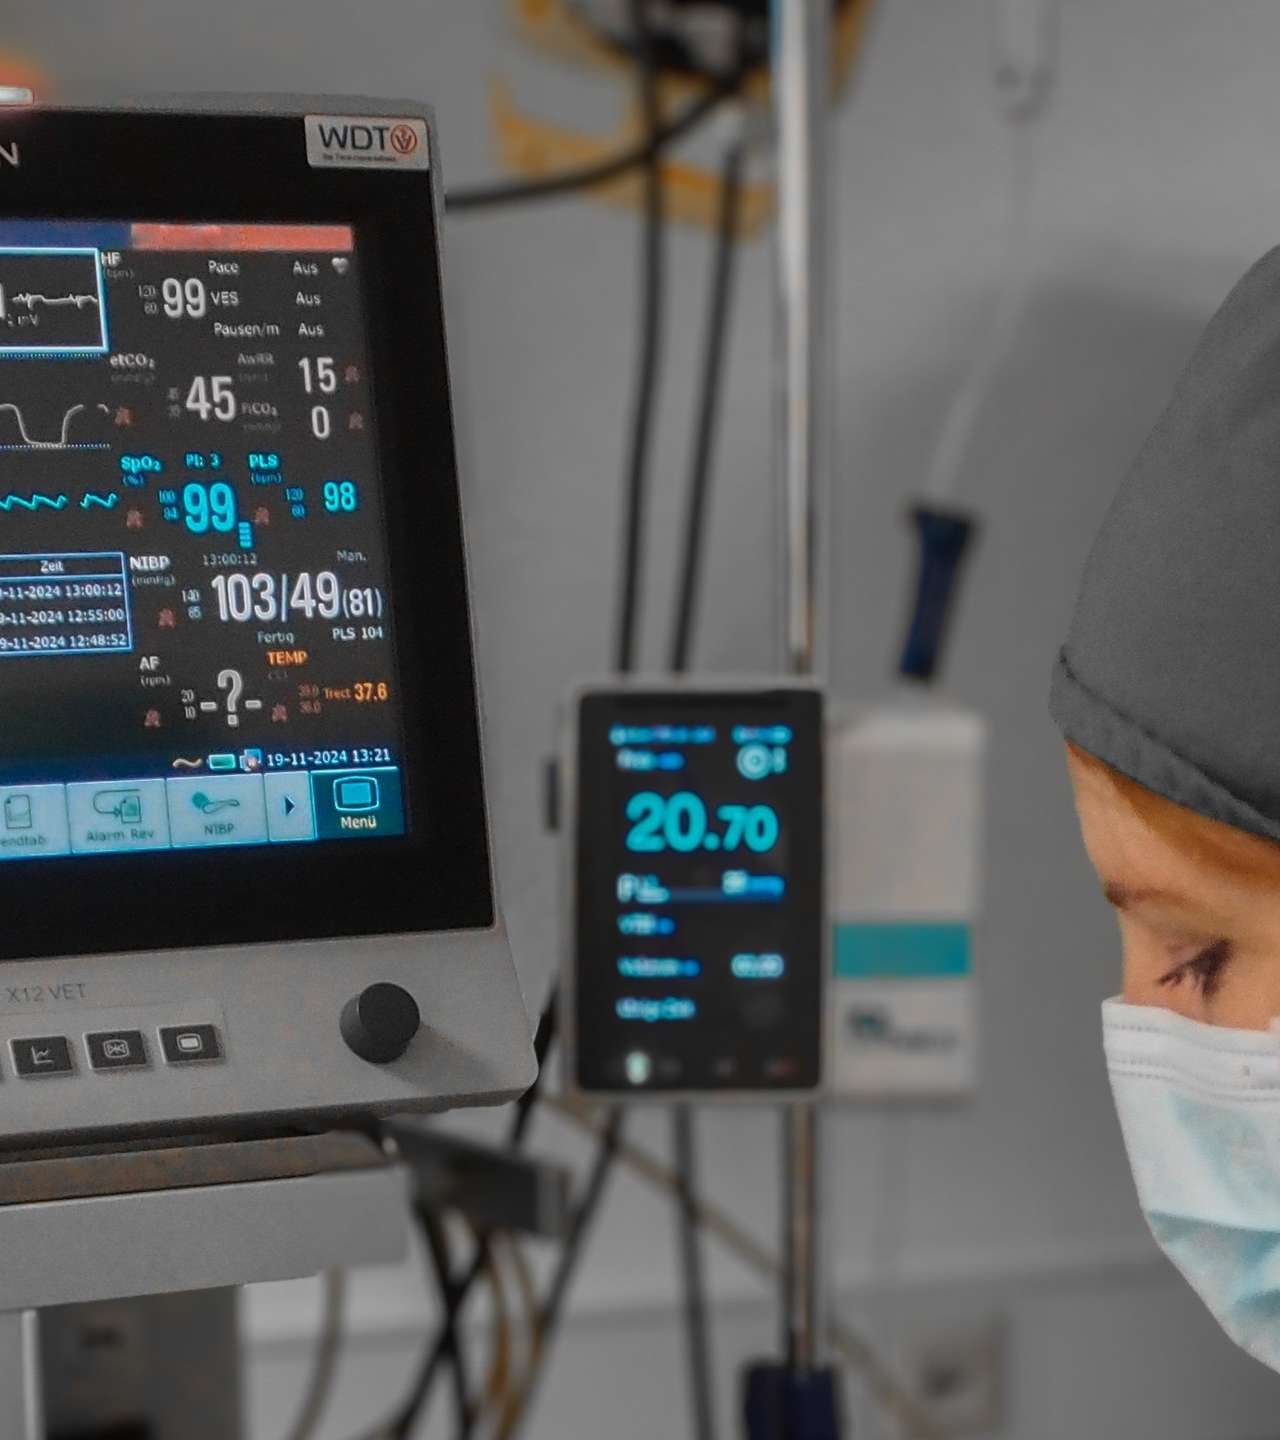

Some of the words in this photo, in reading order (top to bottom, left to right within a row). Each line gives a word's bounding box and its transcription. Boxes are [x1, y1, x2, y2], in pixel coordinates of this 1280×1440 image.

[318, 124, 389, 150] WDT
[208, 260, 239, 275] Pace
[293, 261, 319, 275] Aus
[162, 278, 205, 318] 99
[211, 291, 239, 306] VES
[296, 291, 321, 306] Aus
[214, 322, 279, 337] Pausen/m
[298, 322, 324, 337] Aus
[297, 356, 336, 393] 15
[186, 375, 236, 422] 45
[311, 406, 330, 440] 0
[210, 454, 220, 467] 3
[249, 454, 279, 468] PLS
[324, 481, 357, 512] 98
[183, 482, 236, 533] 99
[40, 559, 65, 573] Zeit
[130, 555, 170, 571] NIBP
[203, 554, 258, 567] 13:00:12
[65, 582, 122, 597] 13:00:12
[67, 608, 125, 623] 12:55:00
[70, 633, 127, 648] 12:48:52
[332, 628, 356, 641] PLS
[361, 626, 384, 640] 104
[140, 656, 161, 670] AF
[267, 651, 309, 666] TEMP
[354, 682, 388, 701] 37.6
[267, 750, 347, 767] 19-11-2024
[352, 748, 391, 763] 13:21
[340, 815, 377, 829] Menü
[625, 791, 780, 853] 20.70
[86, 829, 126, 842] Alarm
[130, 827, 154, 840] Rev
[204, 823, 235, 837] NIBP
[47, 983, 87, 1000] VET
